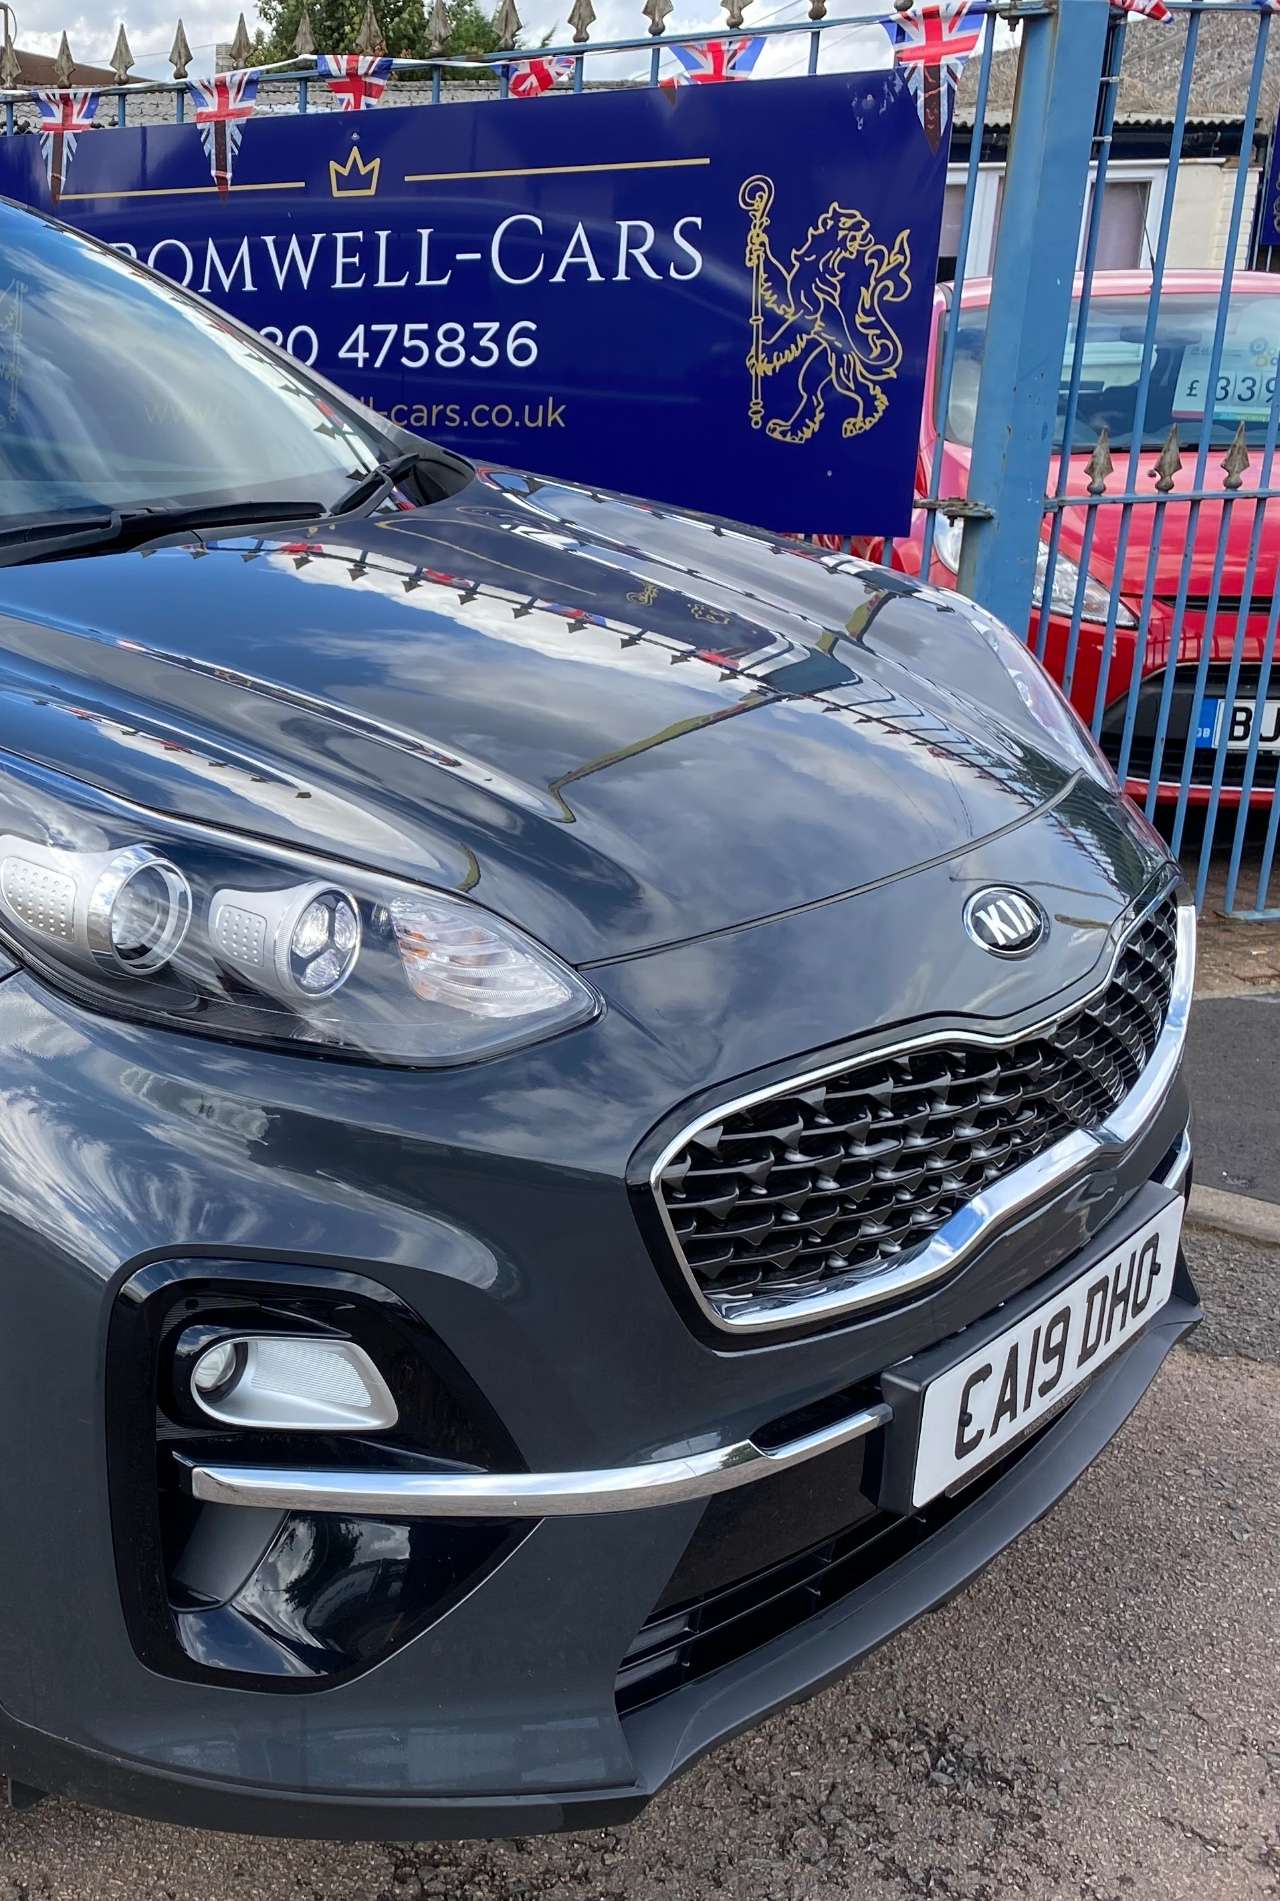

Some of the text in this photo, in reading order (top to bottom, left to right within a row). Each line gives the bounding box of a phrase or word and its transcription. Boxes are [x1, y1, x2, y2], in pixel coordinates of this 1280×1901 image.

[108, 214, 703, 293] OMWELL-CARS
[338, 321, 538, 368] 475836
[975, 894, 1041, 946] KIA
[954, 1305, 1072, 1460] CA19
[1076, 1232, 1161, 1369] DHO
